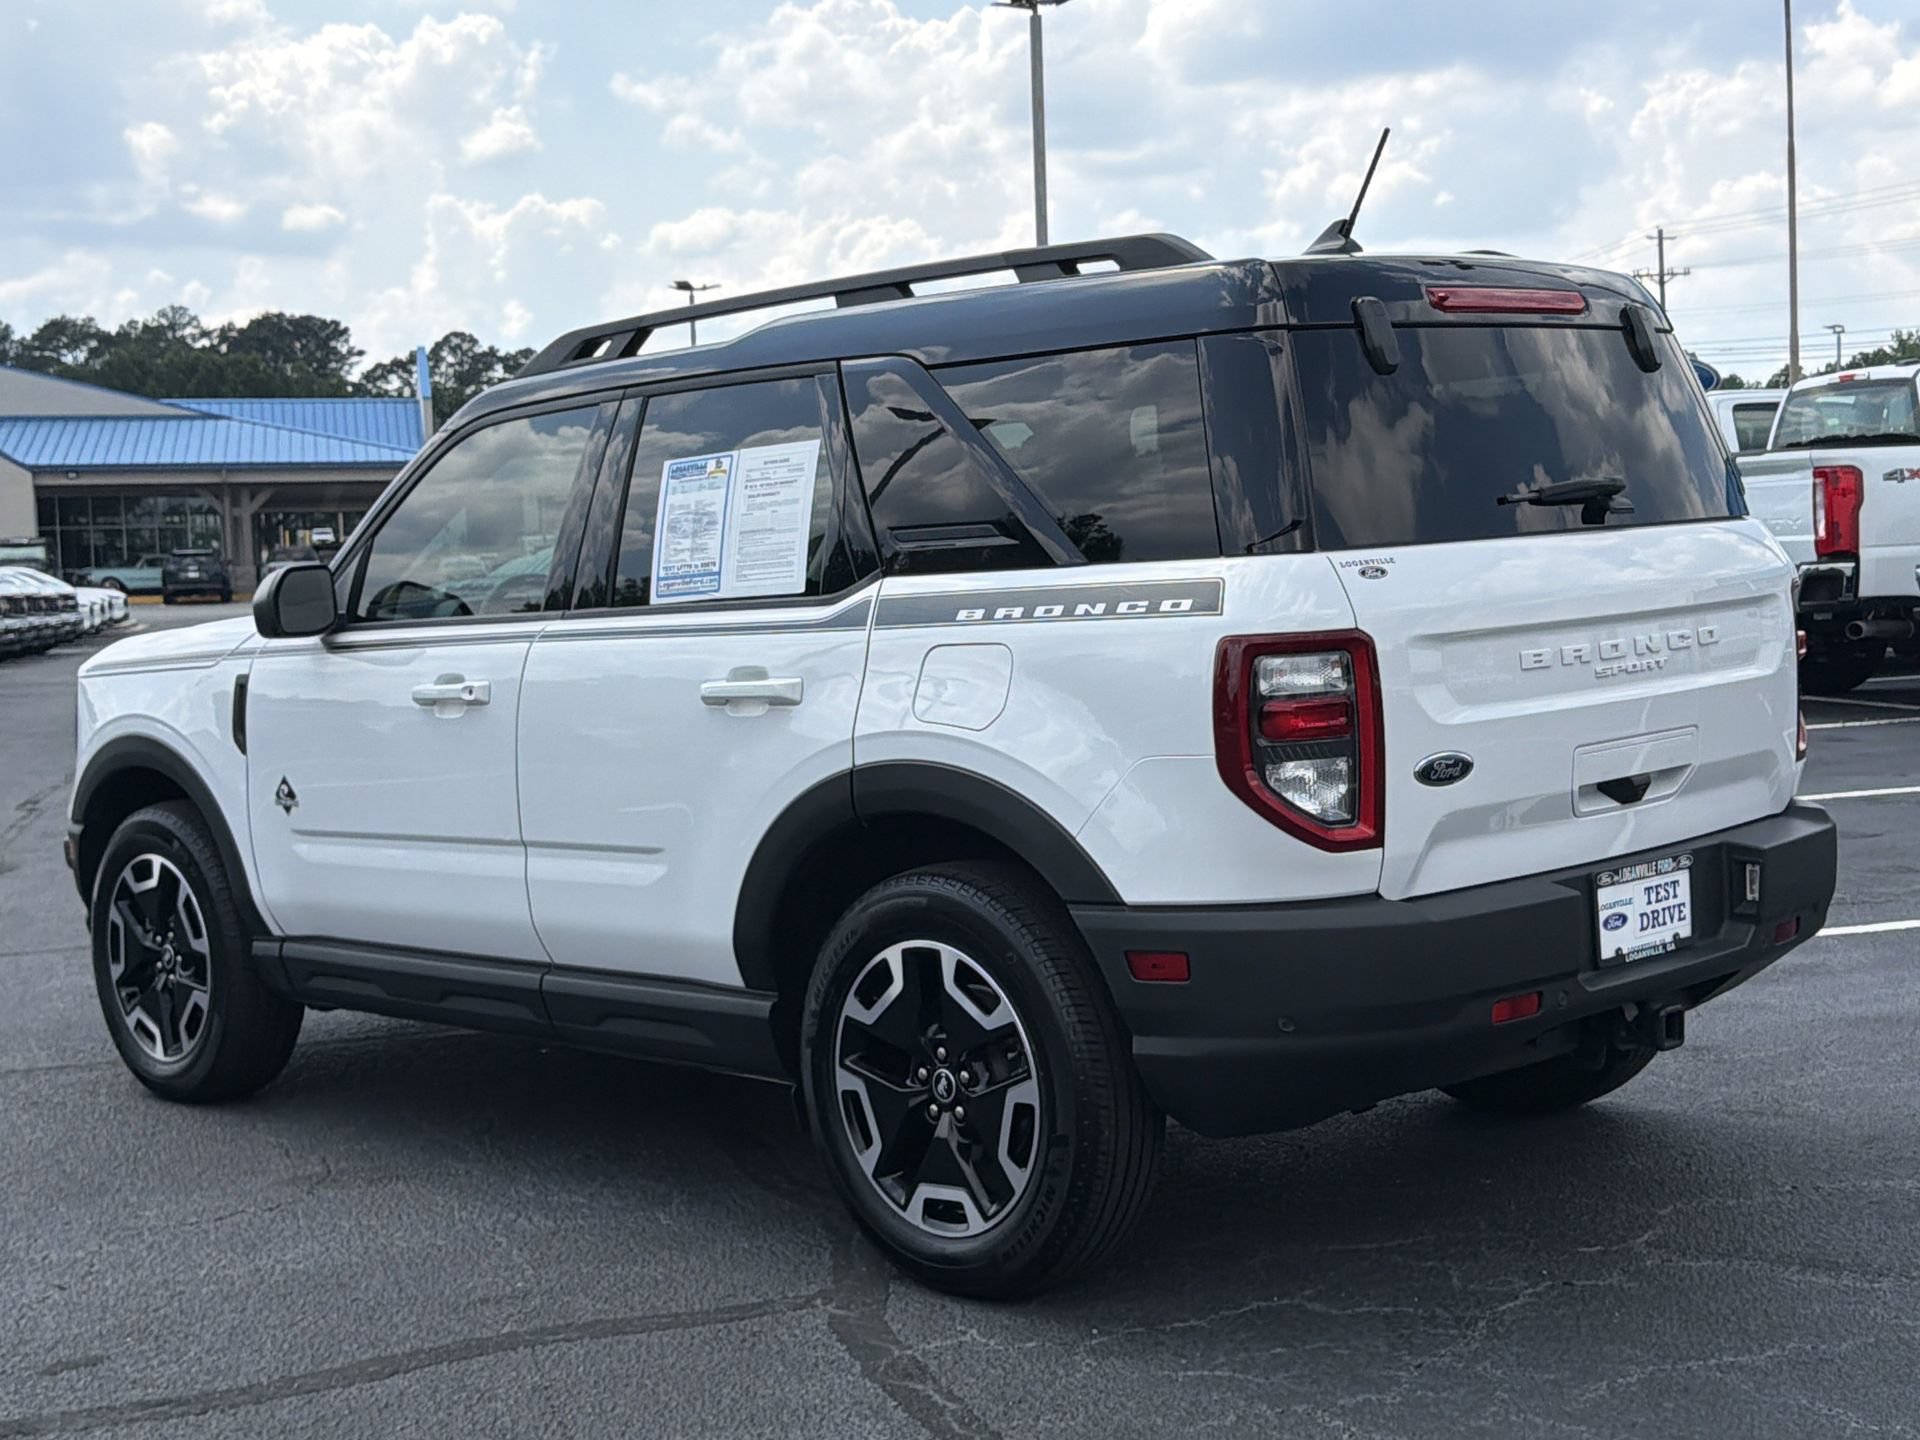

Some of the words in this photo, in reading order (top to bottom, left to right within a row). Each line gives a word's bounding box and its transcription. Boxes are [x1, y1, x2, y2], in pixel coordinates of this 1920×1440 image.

[1339, 557, 1396, 569] LOGANVILLE
[955, 598, 1194, 621] BRONCO
[1519, 625, 1720, 671] BRONCO
[1595, 656, 1669, 678] SPORT
[1430, 758, 1463, 780] Ford
[1643, 880, 1680, 905] TEST
[1639, 902, 1687, 932] DRIVE
